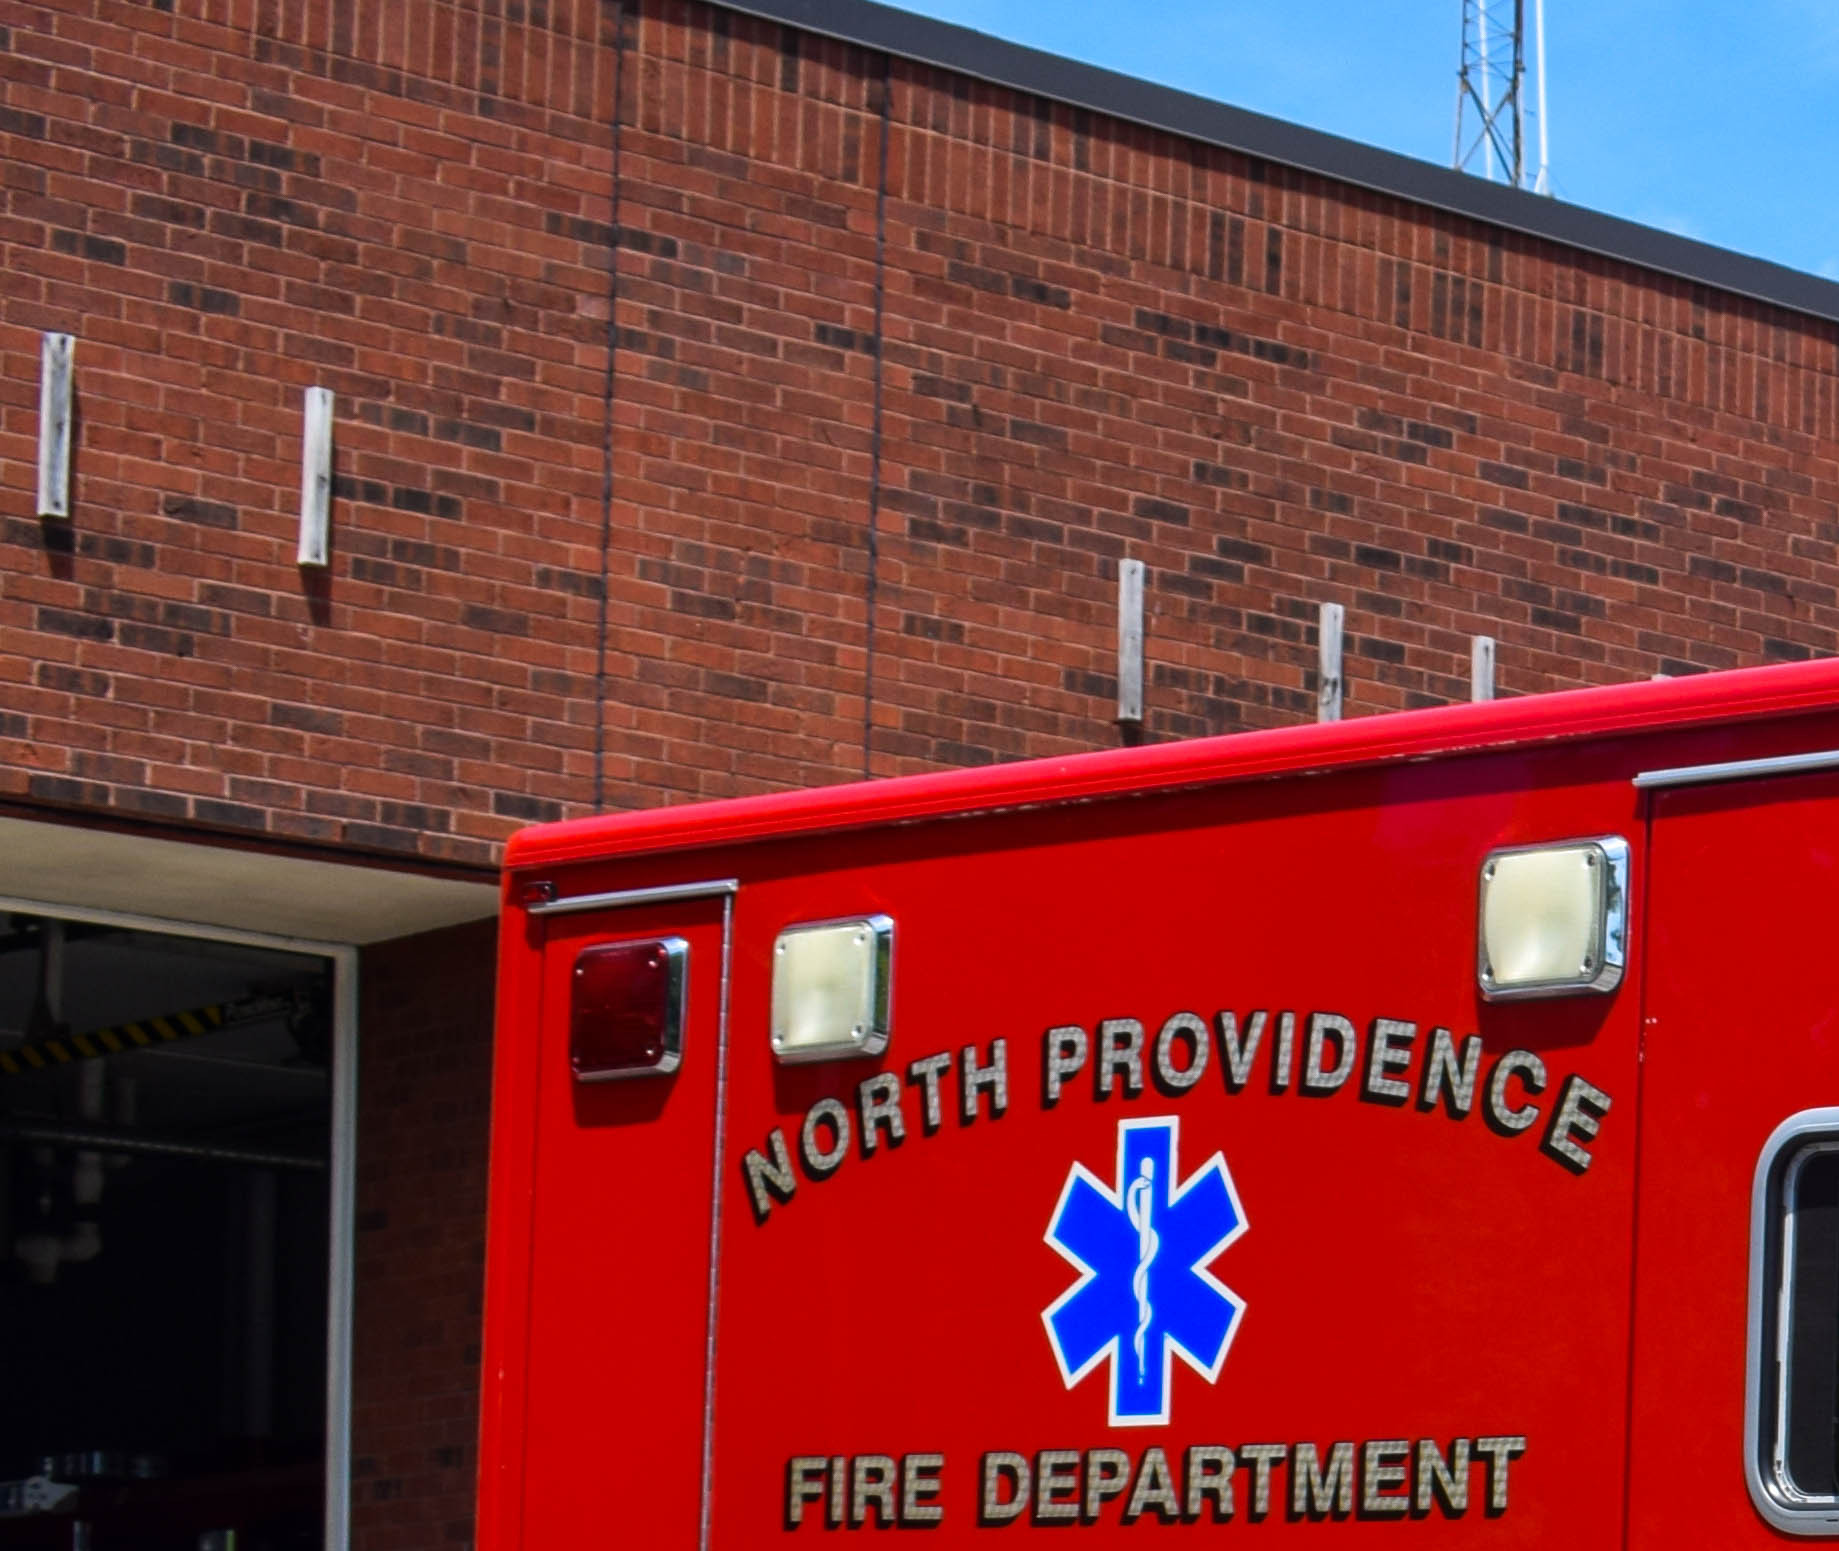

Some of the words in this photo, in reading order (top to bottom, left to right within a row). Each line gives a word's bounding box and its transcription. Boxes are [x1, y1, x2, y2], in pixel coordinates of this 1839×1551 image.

[741, 1036, 1010, 1220] NORTH
[1042, 1007, 1615, 1172] PROVIDENCE
[785, 1453, 946, 1527] FIRE
[979, 1436, 1528, 1525] DEPARTMENT
